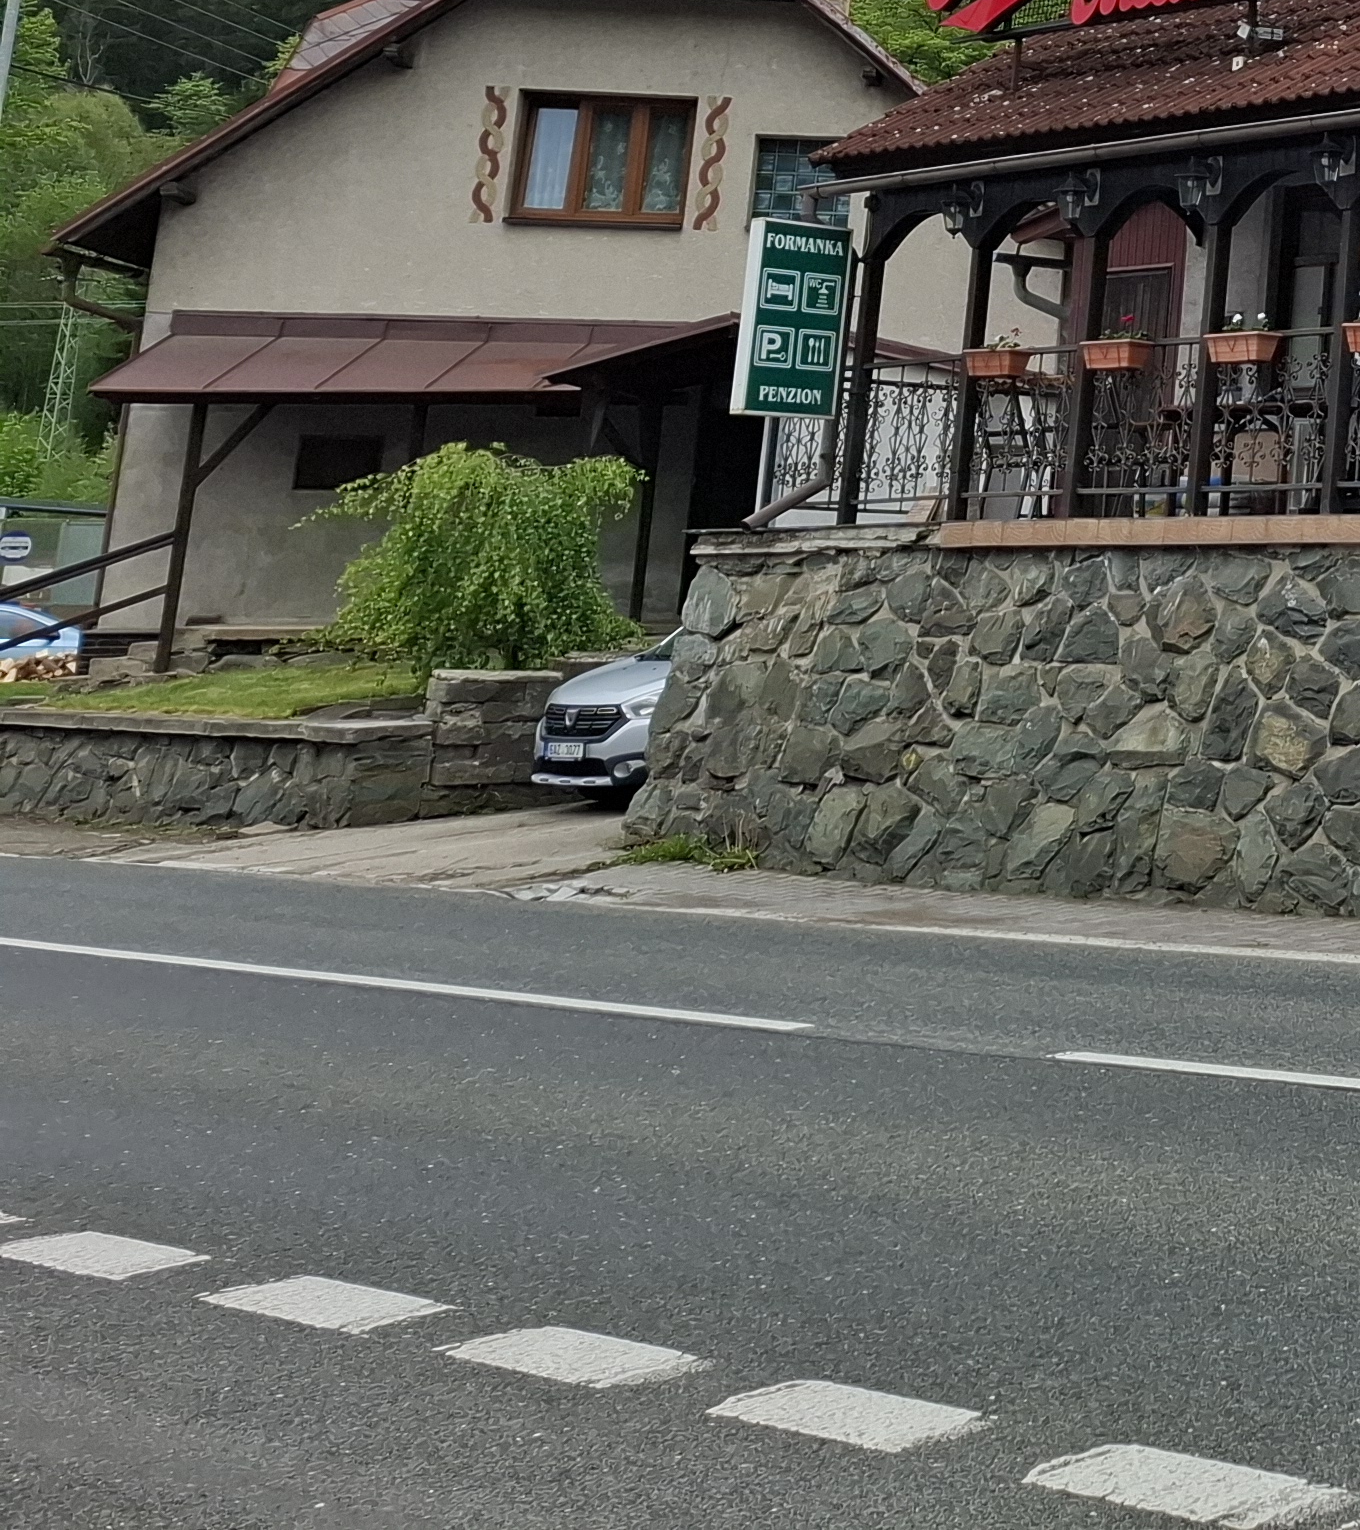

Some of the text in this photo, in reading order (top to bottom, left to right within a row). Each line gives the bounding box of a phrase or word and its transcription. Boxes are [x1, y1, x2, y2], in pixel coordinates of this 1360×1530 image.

[766, 232, 844, 257] FORMANKA
[808, 278, 822, 289] WC
[758, 385, 822, 405] PENZION
